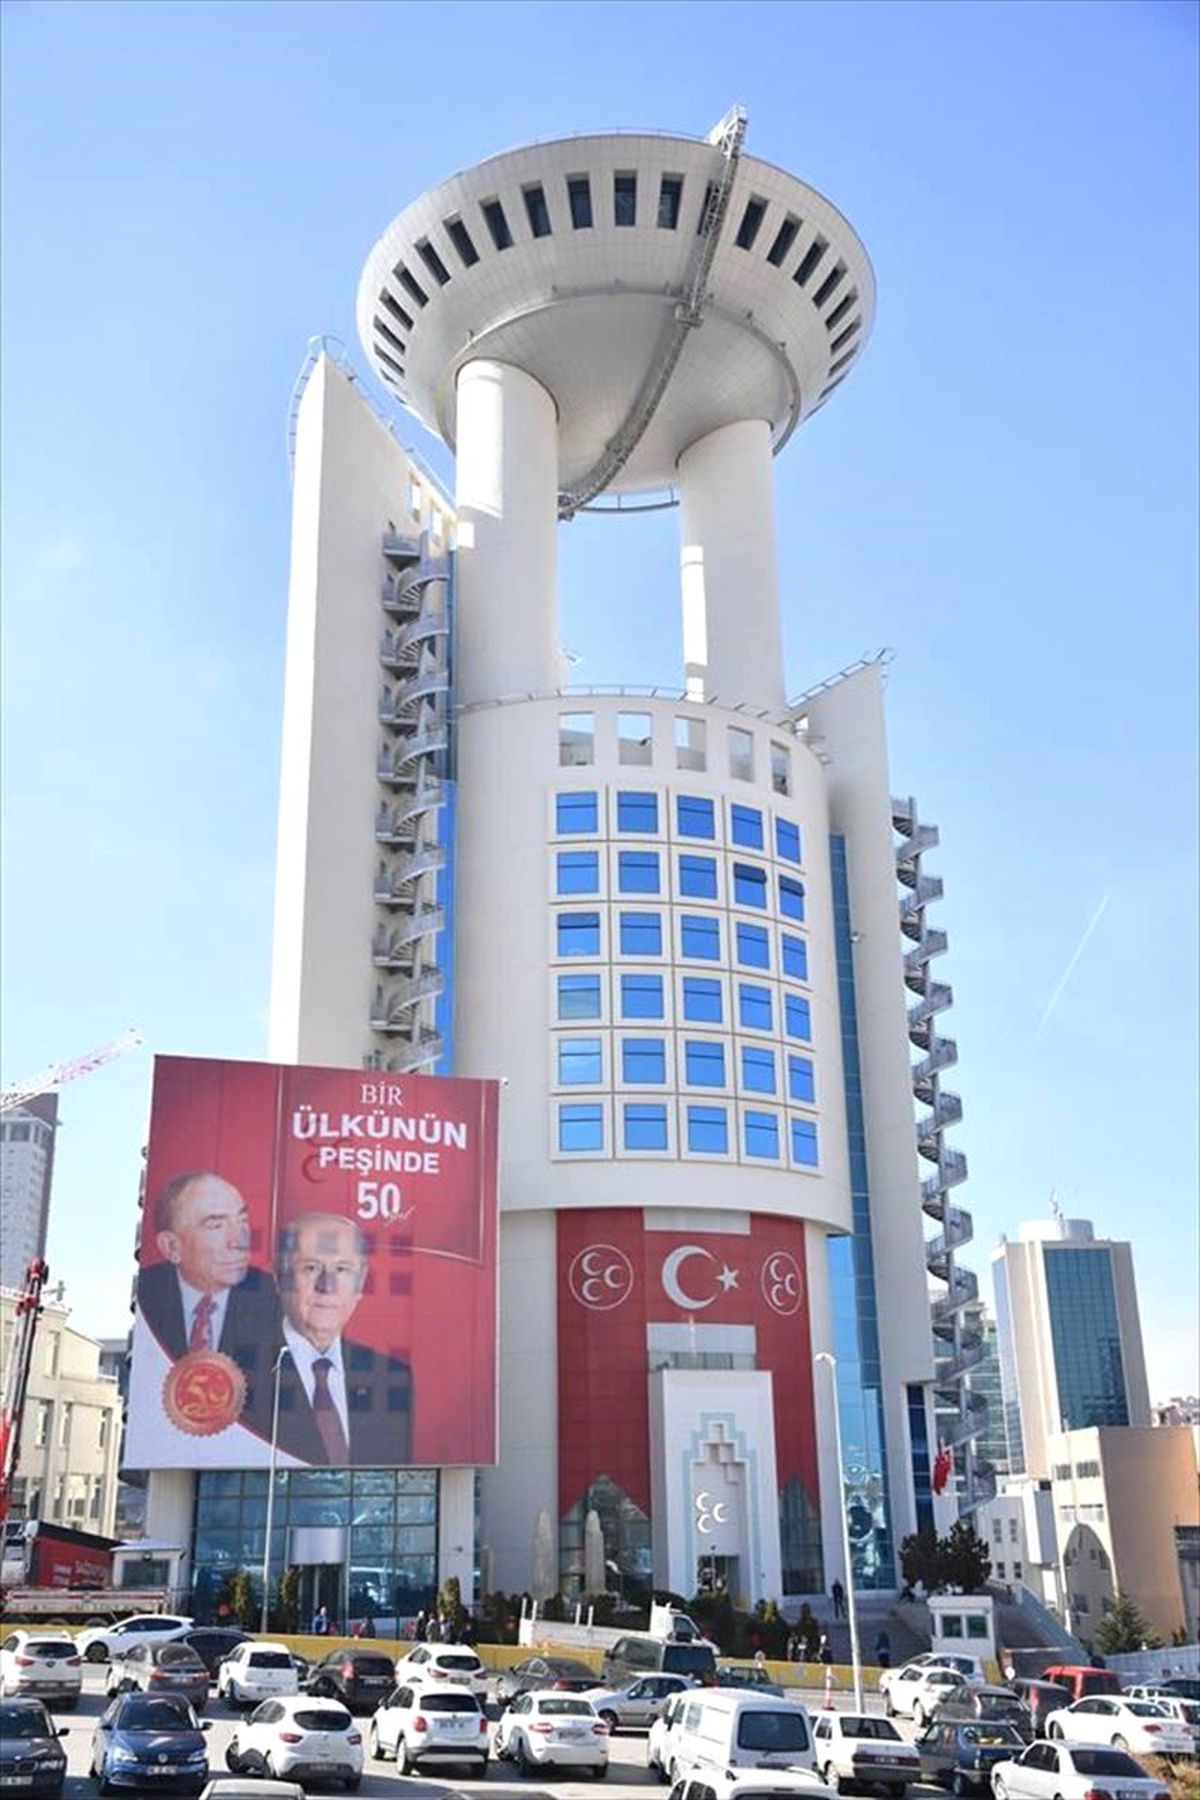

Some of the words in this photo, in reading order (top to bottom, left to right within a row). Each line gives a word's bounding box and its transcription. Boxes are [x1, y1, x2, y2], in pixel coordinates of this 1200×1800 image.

[360, 1081, 403, 1106] BİR
[293, 1104, 467, 1149] ÜLKÜNÜN
[319, 1144, 440, 1176] PEŞİNDE
[356, 1181, 401, 1219] 50
